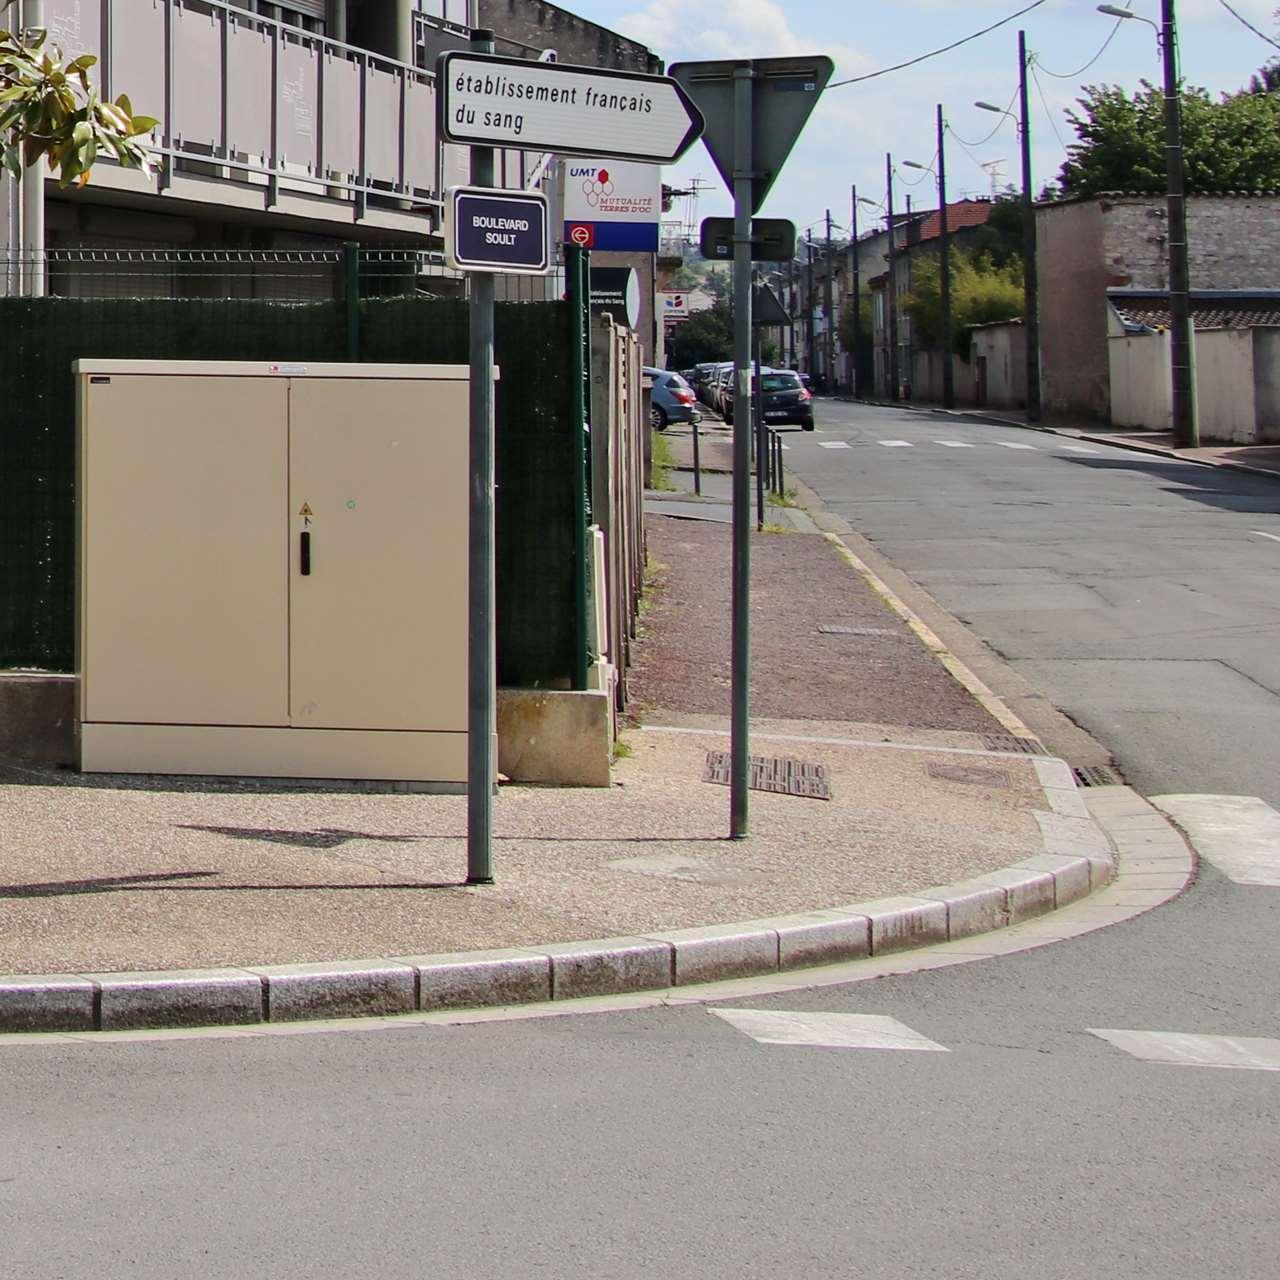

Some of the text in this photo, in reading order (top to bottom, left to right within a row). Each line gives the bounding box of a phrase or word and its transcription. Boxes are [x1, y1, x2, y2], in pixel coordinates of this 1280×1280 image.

[455, 73, 653, 113] établissement français
[455, 104, 524, 135] du sang
[569, 168, 597, 177] UMT
[600, 197, 653, 205] MUTUALITÉ
[599, 205, 630, 213] TERRES
[472, 216, 529, 231] BOULEVARD
[485, 232, 516, 245] SOULT
